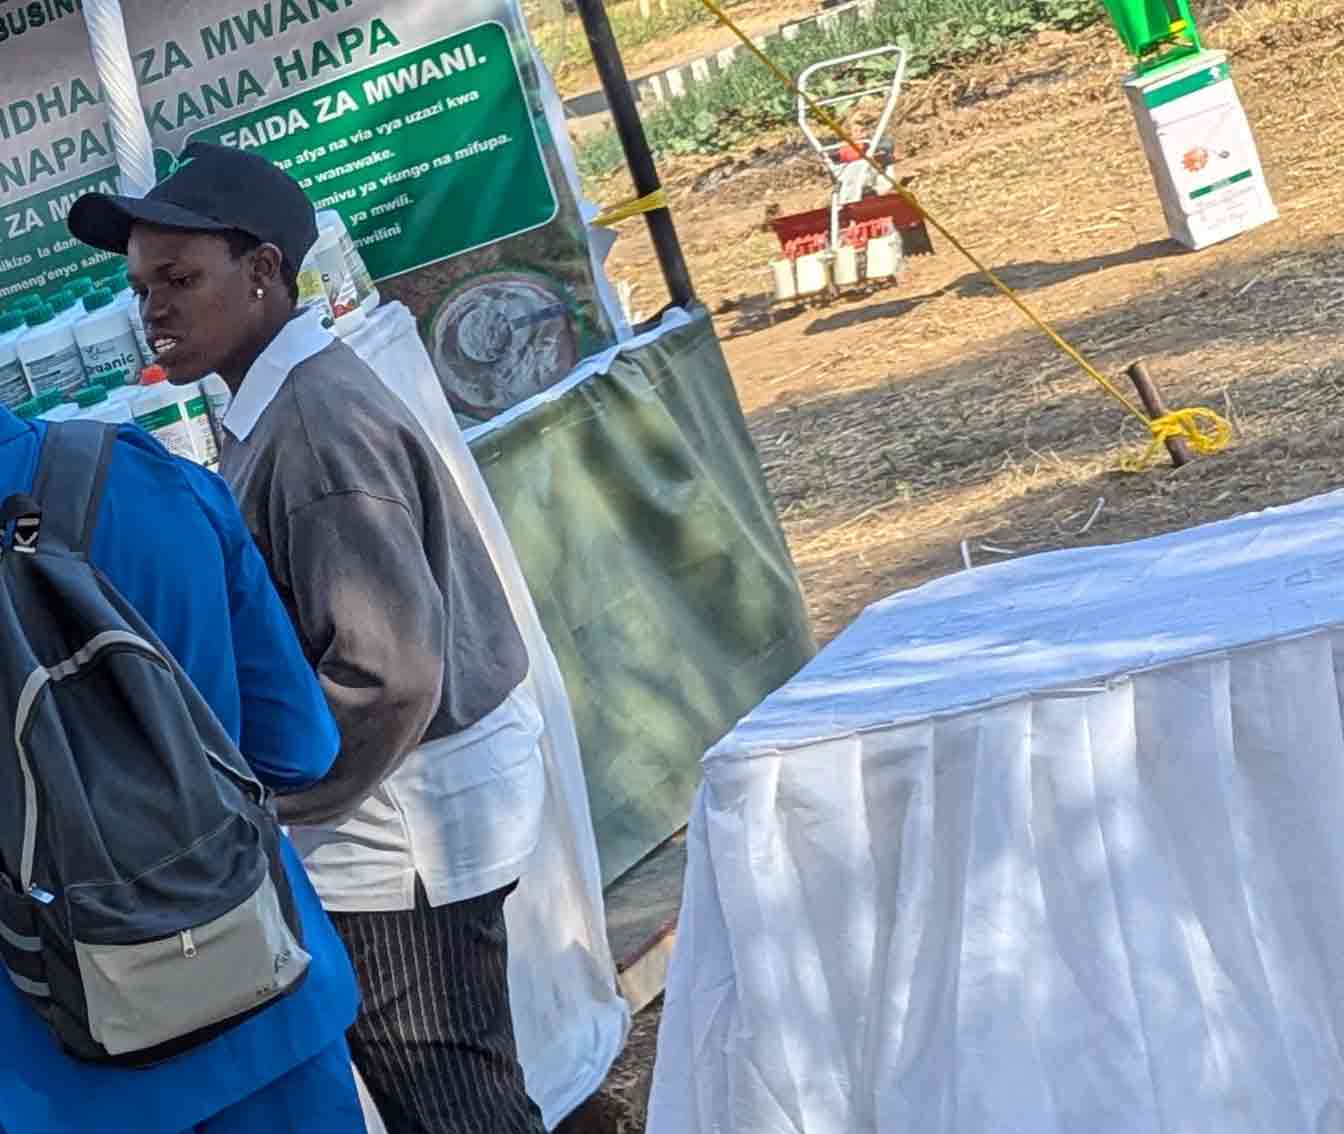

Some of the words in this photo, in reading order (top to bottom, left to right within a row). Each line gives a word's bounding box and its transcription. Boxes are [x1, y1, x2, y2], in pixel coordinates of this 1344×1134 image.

[133, 40, 194, 86] ZA
[274, 17, 401, 88] HAPA
[218, 108, 309, 151] FAIDA
[314, 89, 359, 125] ZA
[362, 42, 487, 106] MWANI.
[295, 145, 327, 169] afya
[328, 137, 349, 151] na
[350, 125, 374, 147] via
[374, 118, 403, 138] vya
[404, 100, 445, 124] uzazi
[446, 88, 480, 107] kwa
[313, 148, 396, 184] wanawake.
[358, 181, 378, 197] ya
[379, 160, 431, 188] viungo
[431, 152, 453, 169] na
[454, 133, 514, 162] mifupa.
[4, 207, 45, 240] ZA
[348, 209, 368, 227] ya
